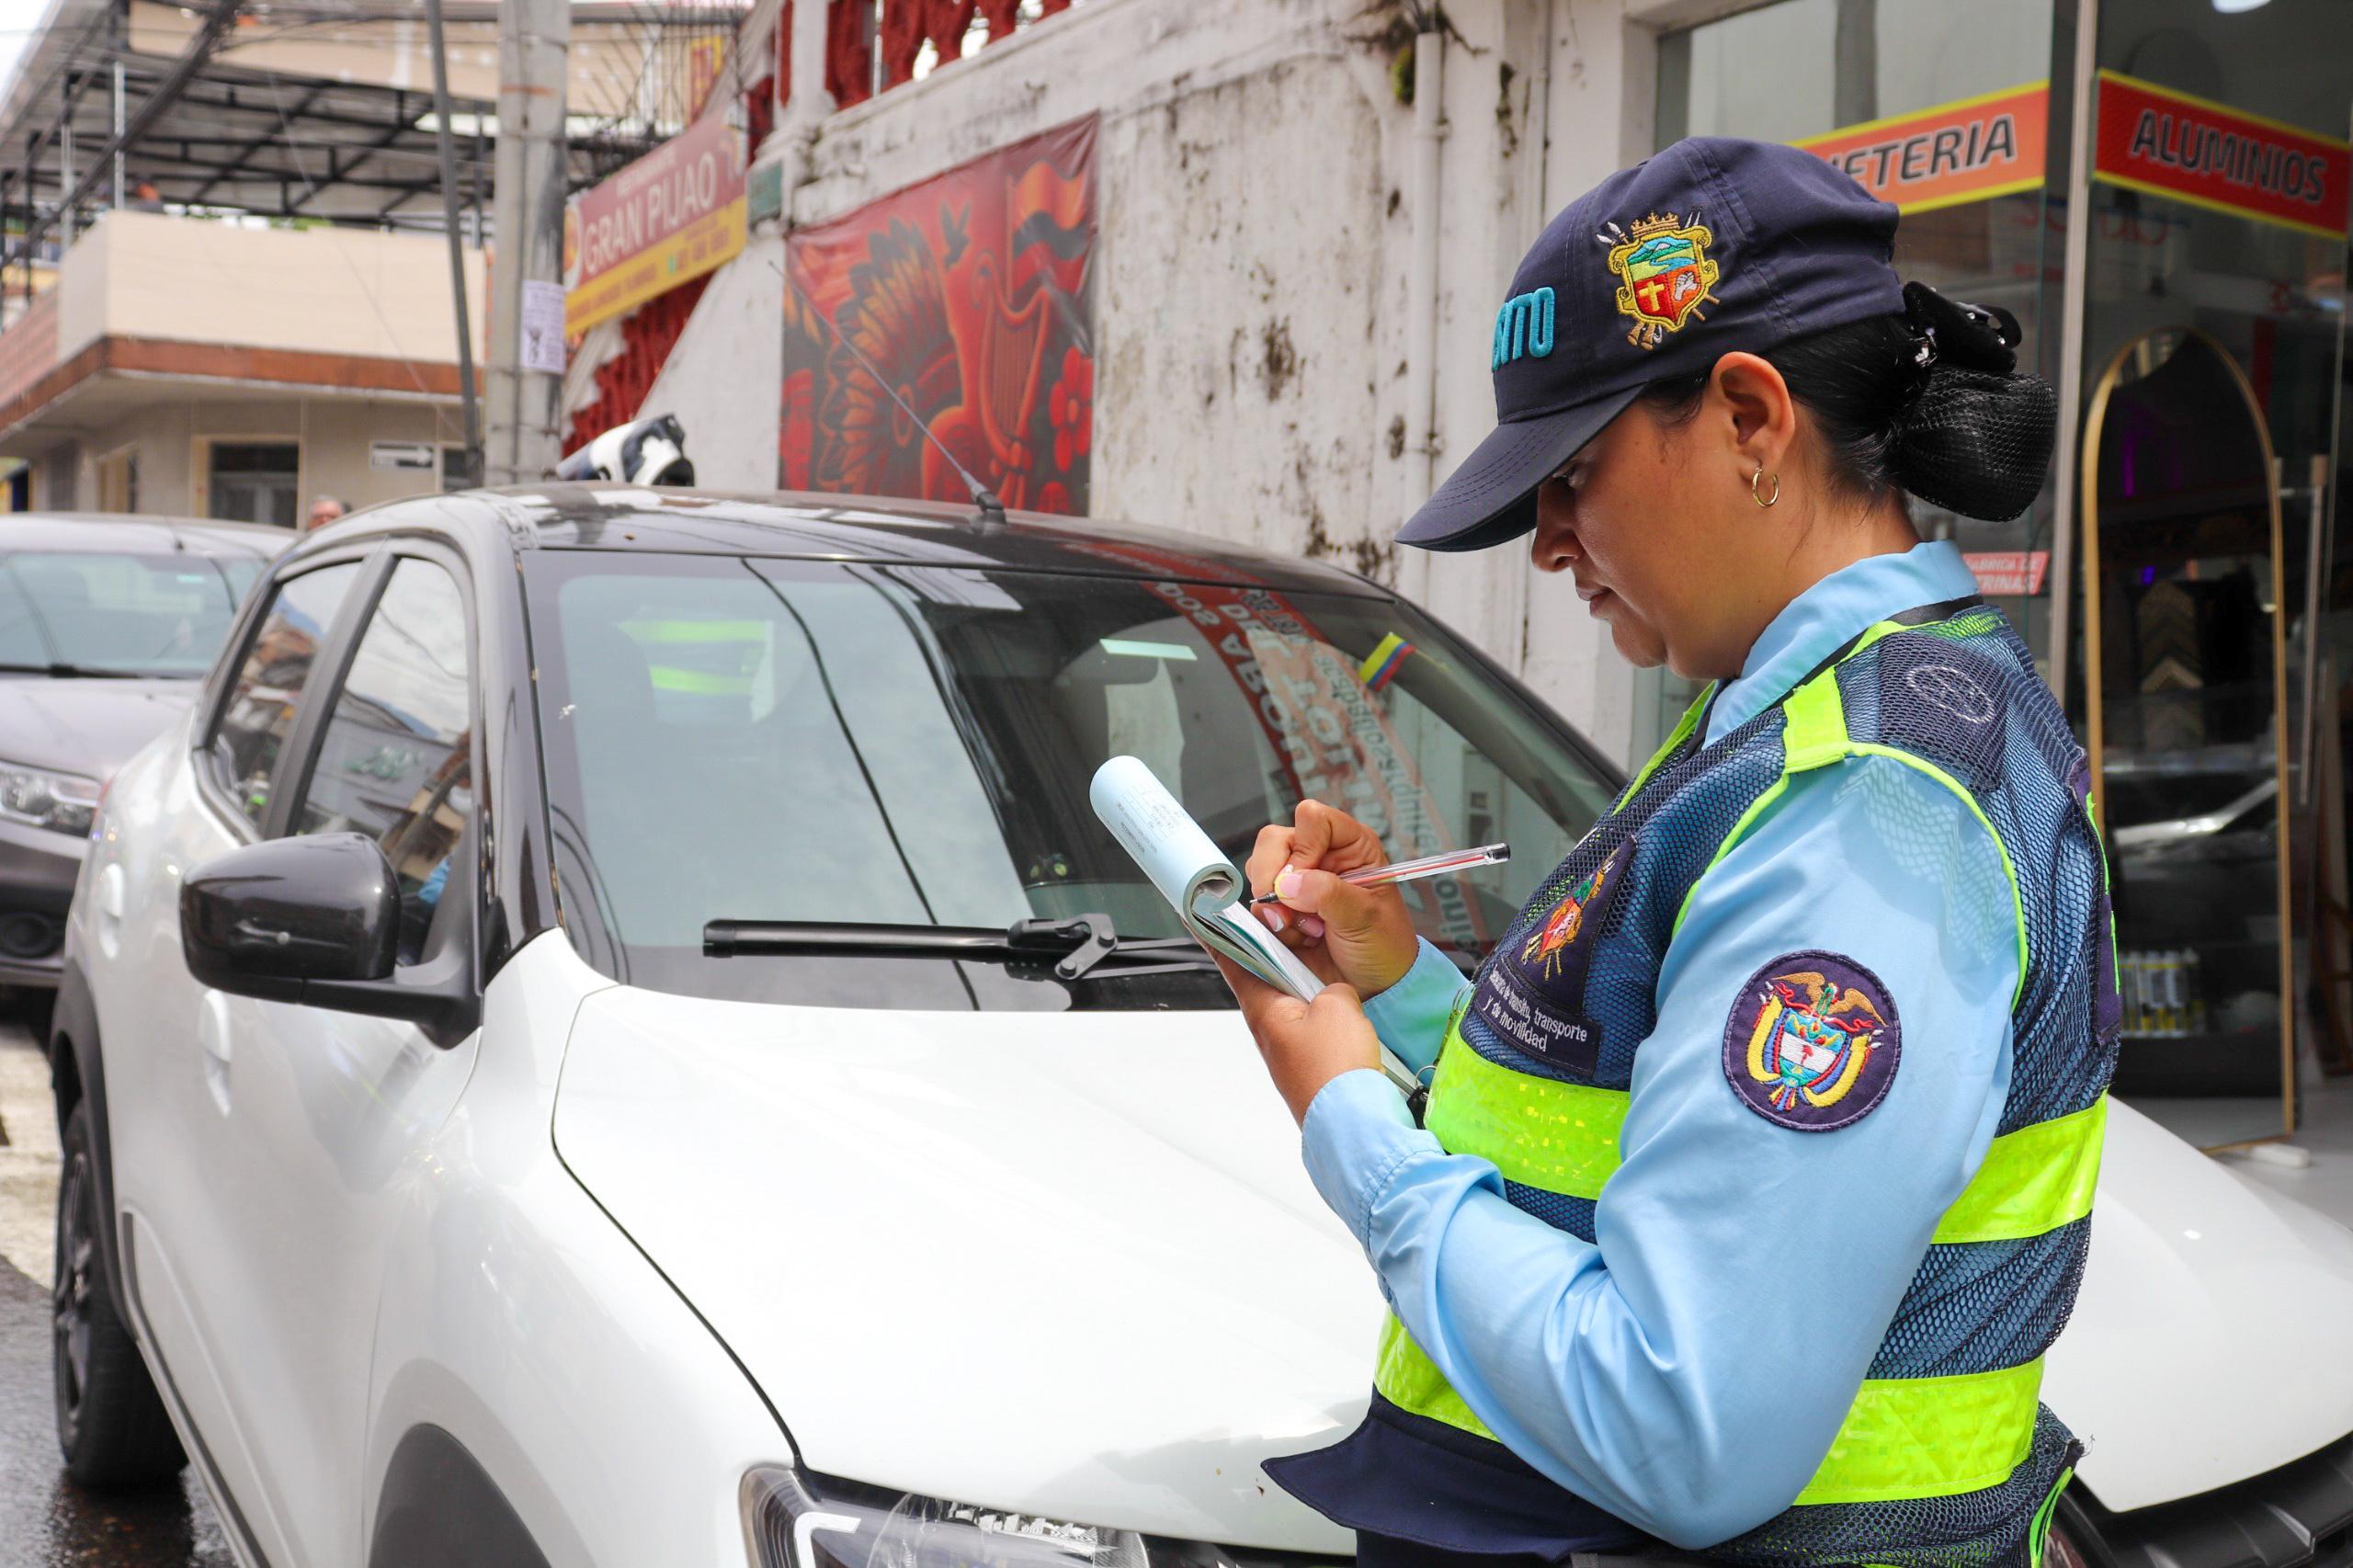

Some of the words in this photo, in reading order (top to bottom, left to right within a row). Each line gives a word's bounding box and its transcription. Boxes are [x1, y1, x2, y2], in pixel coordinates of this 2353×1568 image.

[1832, 115, 2016, 189] ETERIA
[2132, 108, 2328, 205] ALUMINIOS
[584, 194, 642, 274] GRAN
[647, 151, 717, 239] PIJAO
[1483, 994, 1495, 1011] y
[1500, 1010, 1548, 1052] movilidad
[1533, 1007, 1587, 1041] transporte
